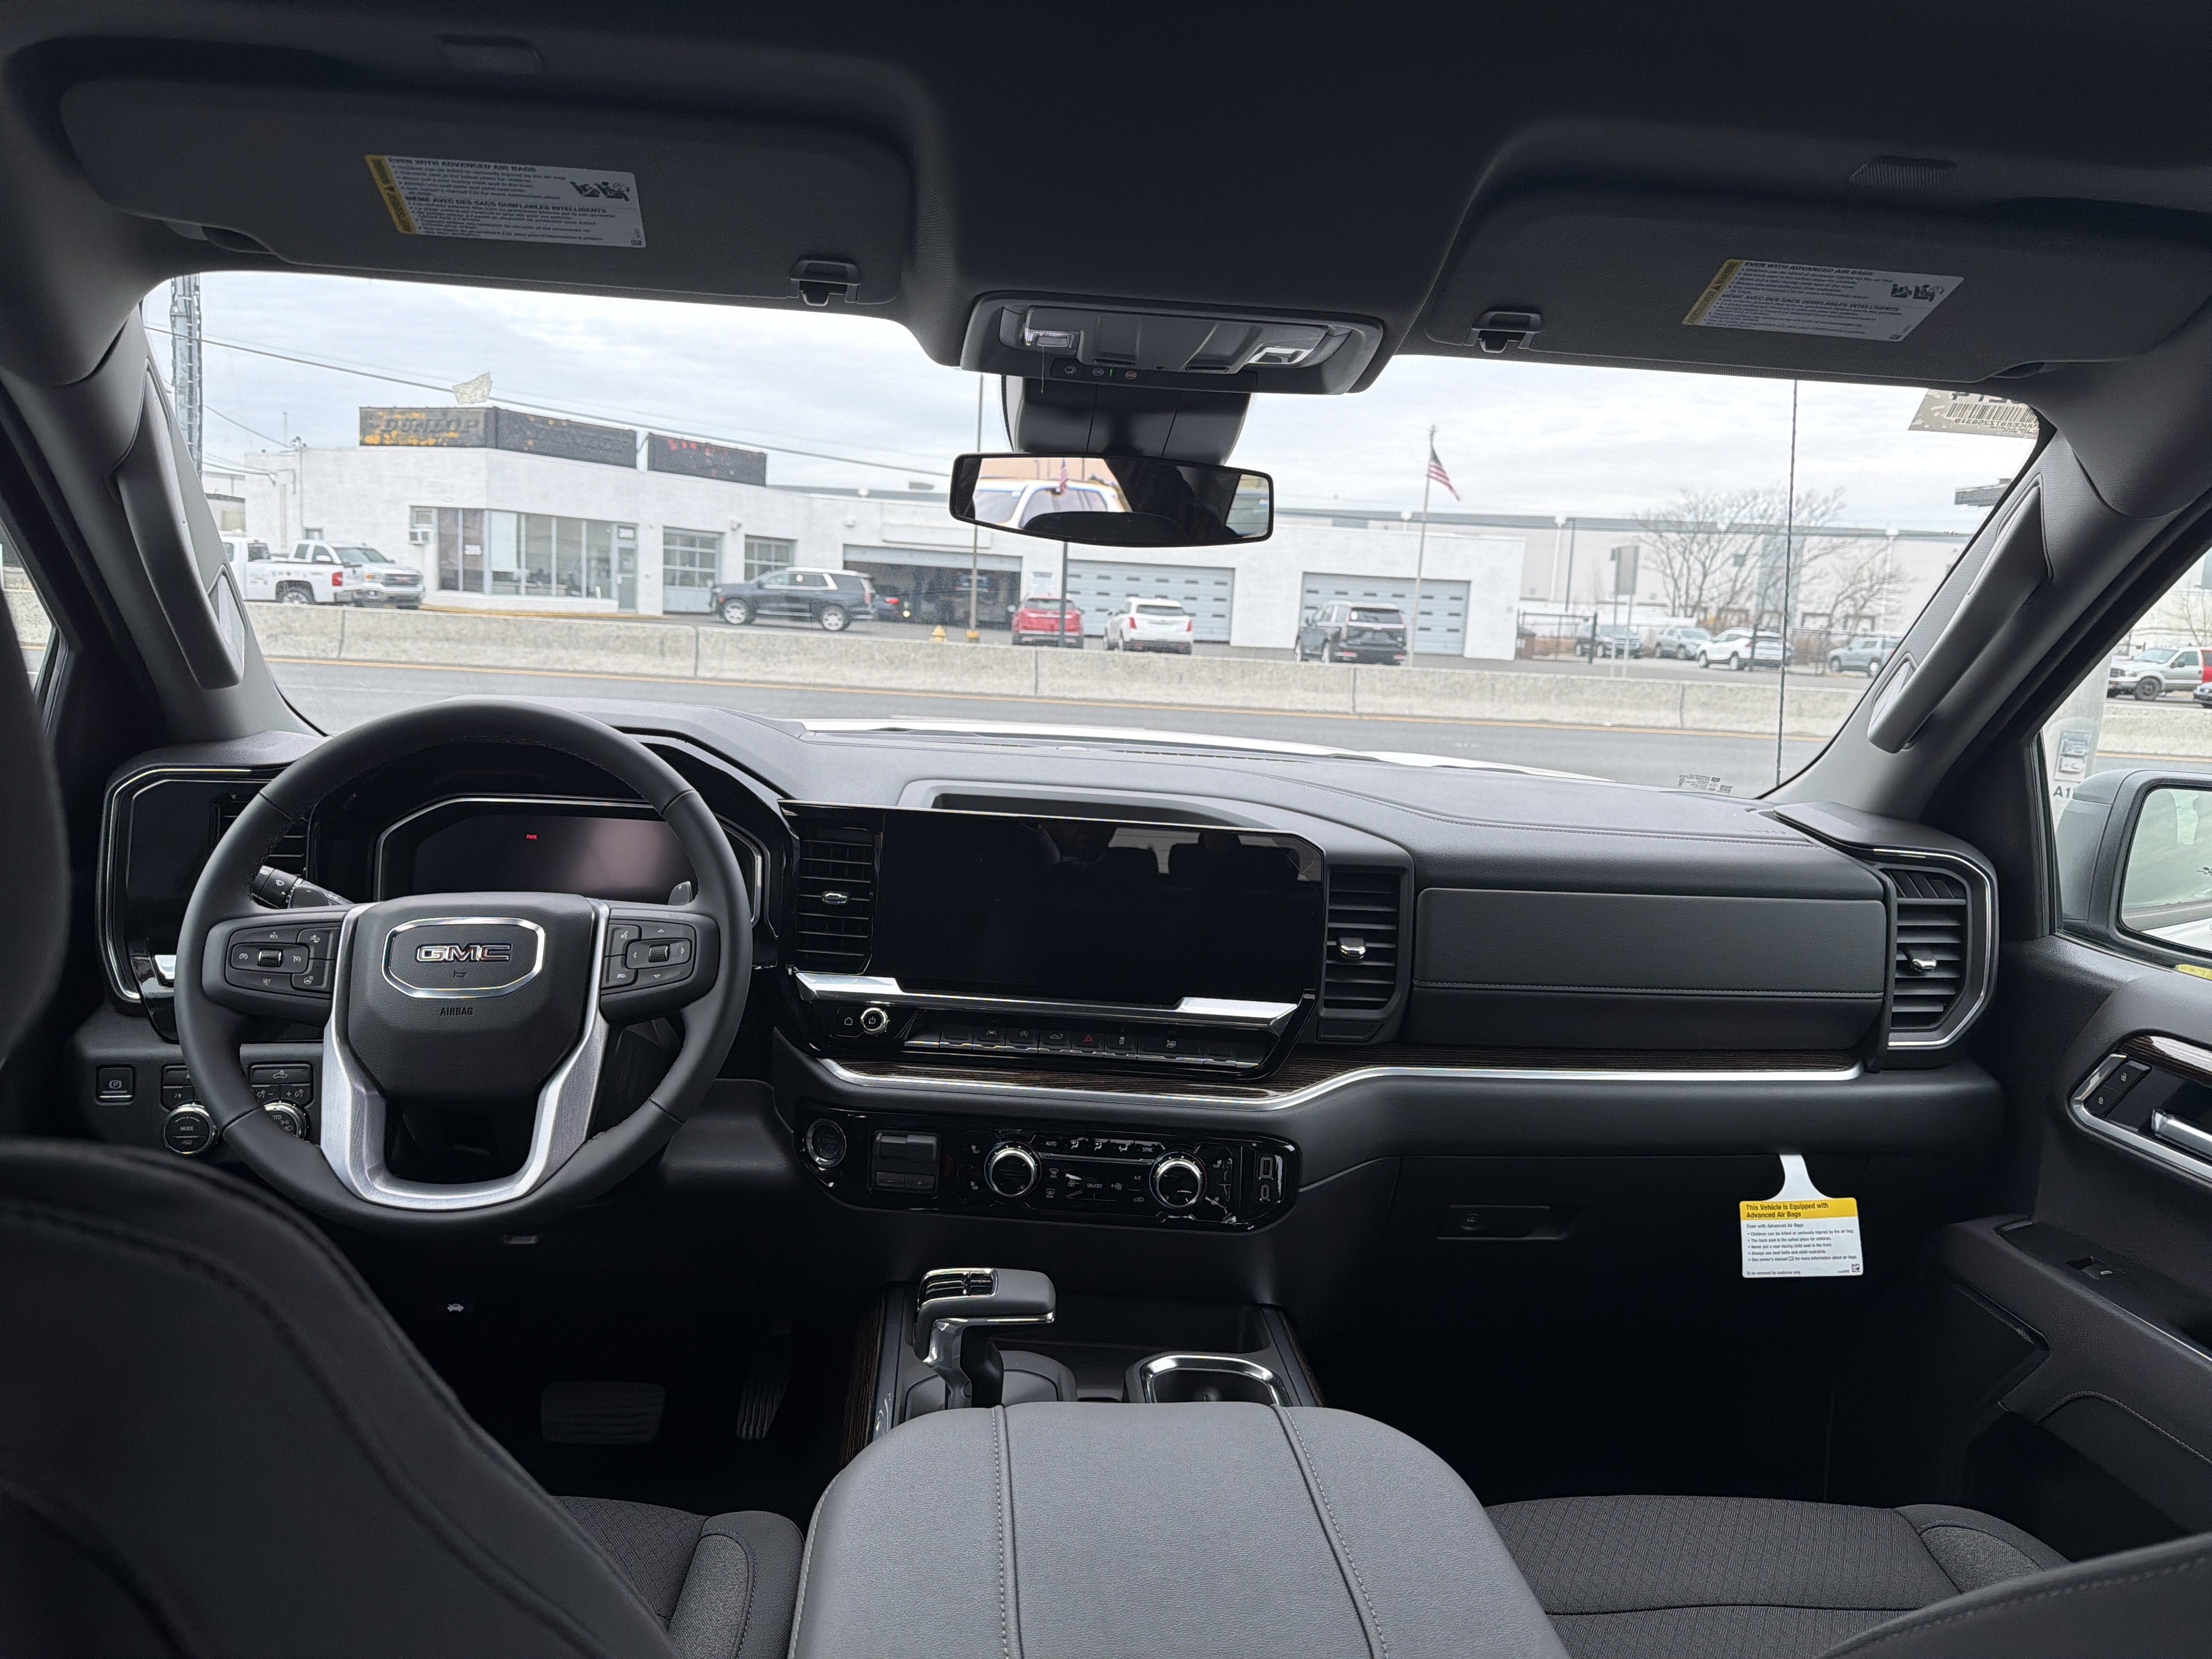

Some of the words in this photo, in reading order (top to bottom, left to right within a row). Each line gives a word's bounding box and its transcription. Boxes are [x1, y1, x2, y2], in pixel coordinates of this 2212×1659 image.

[441, 161, 491, 170] ADVANCED
[551, 205, 607, 213] INTELLIGENTS
[1791, 264, 1834, 273] ADVANCED
[2053, 786, 2076, 798] A1
[416, 944, 512, 962] GMC
[440, 1007, 473, 1016] AIRBAG
[1790, 1203, 1815, 1211] Equipped
